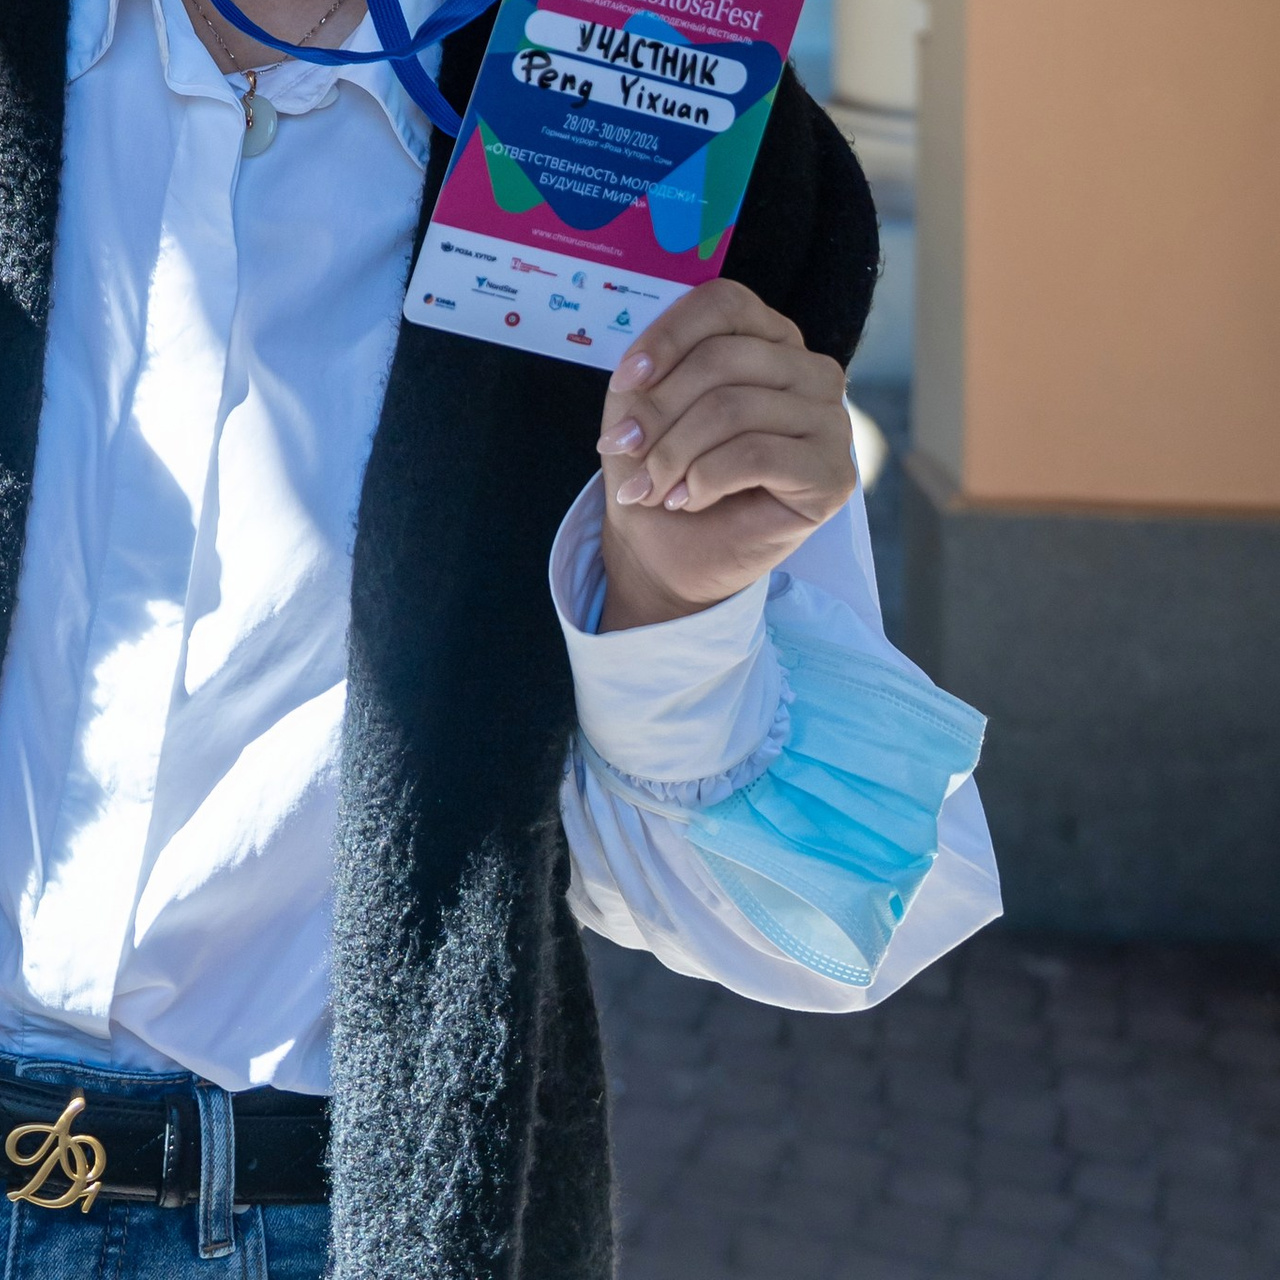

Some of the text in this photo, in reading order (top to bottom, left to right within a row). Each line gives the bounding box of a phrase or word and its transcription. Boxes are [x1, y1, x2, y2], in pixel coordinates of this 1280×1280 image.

[577, 21, 719, 87] УЧАСТНИК
[706, 26, 753, 46] ФЕСТИВАЛЬ
[520, 49, 709, 126] Peng Yixuan
[563, 113, 659, 151] 28/09-30/09/2024
[485, 142, 618, 185] «ОТВЕТСТВЕННОСТЬ
[619, 173, 696, 204] МОЛОДЕЖИ
[539, 172, 646, 208] БУДУЩЕЕ МИРА»
[454, 246, 497, 263] РОЗА ХУТОР
[531, 227, 624, 257] www.chinarusrosafest.ru
[485, 281, 518, 295] NordStar
